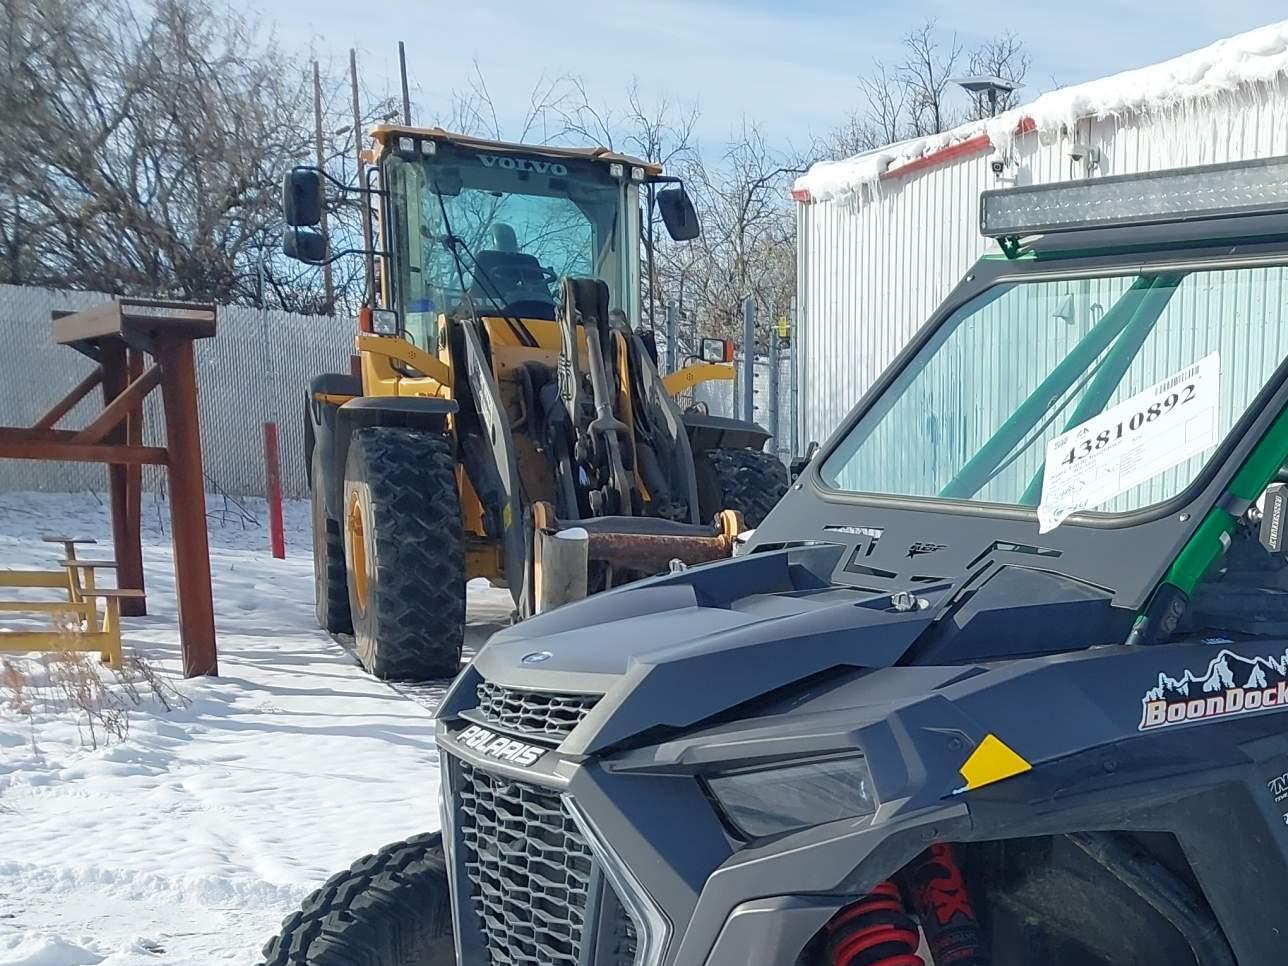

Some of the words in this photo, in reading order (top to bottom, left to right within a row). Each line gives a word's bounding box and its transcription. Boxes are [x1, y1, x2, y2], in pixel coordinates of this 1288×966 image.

[476, 154, 568, 176] VOLVO
[1061, 384, 1196, 466] 43810892
[456, 725, 546, 767] POLARIS
